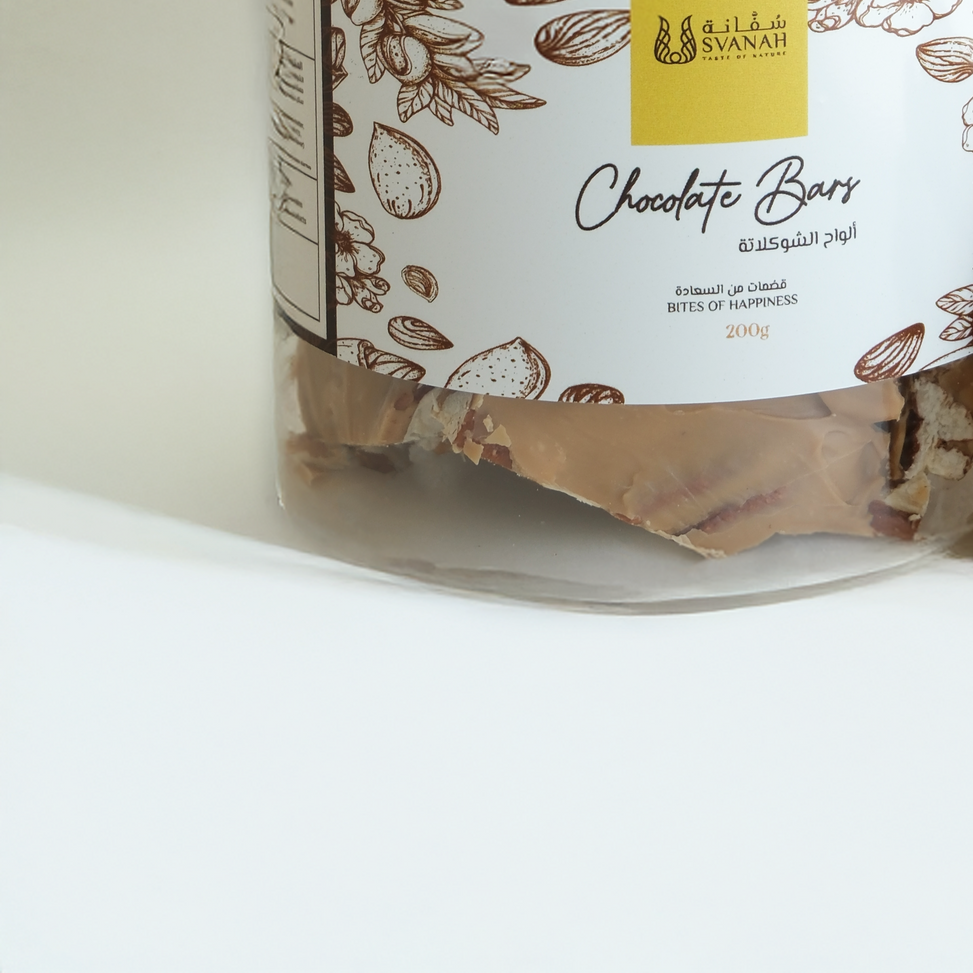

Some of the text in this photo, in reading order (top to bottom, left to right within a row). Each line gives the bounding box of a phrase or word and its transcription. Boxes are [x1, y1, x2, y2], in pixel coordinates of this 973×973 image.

[702, 32, 787, 53] SVANAH
[575, 155, 861, 234] Chocolate Bars
[738, 221, 857, 253] ألواح الشوكلاتة
[675, 279, 787, 296] قضمات من السعادة
[667, 294, 798, 313] BITES OF HAPPINESS
[726, 322, 770, 340] 200g
